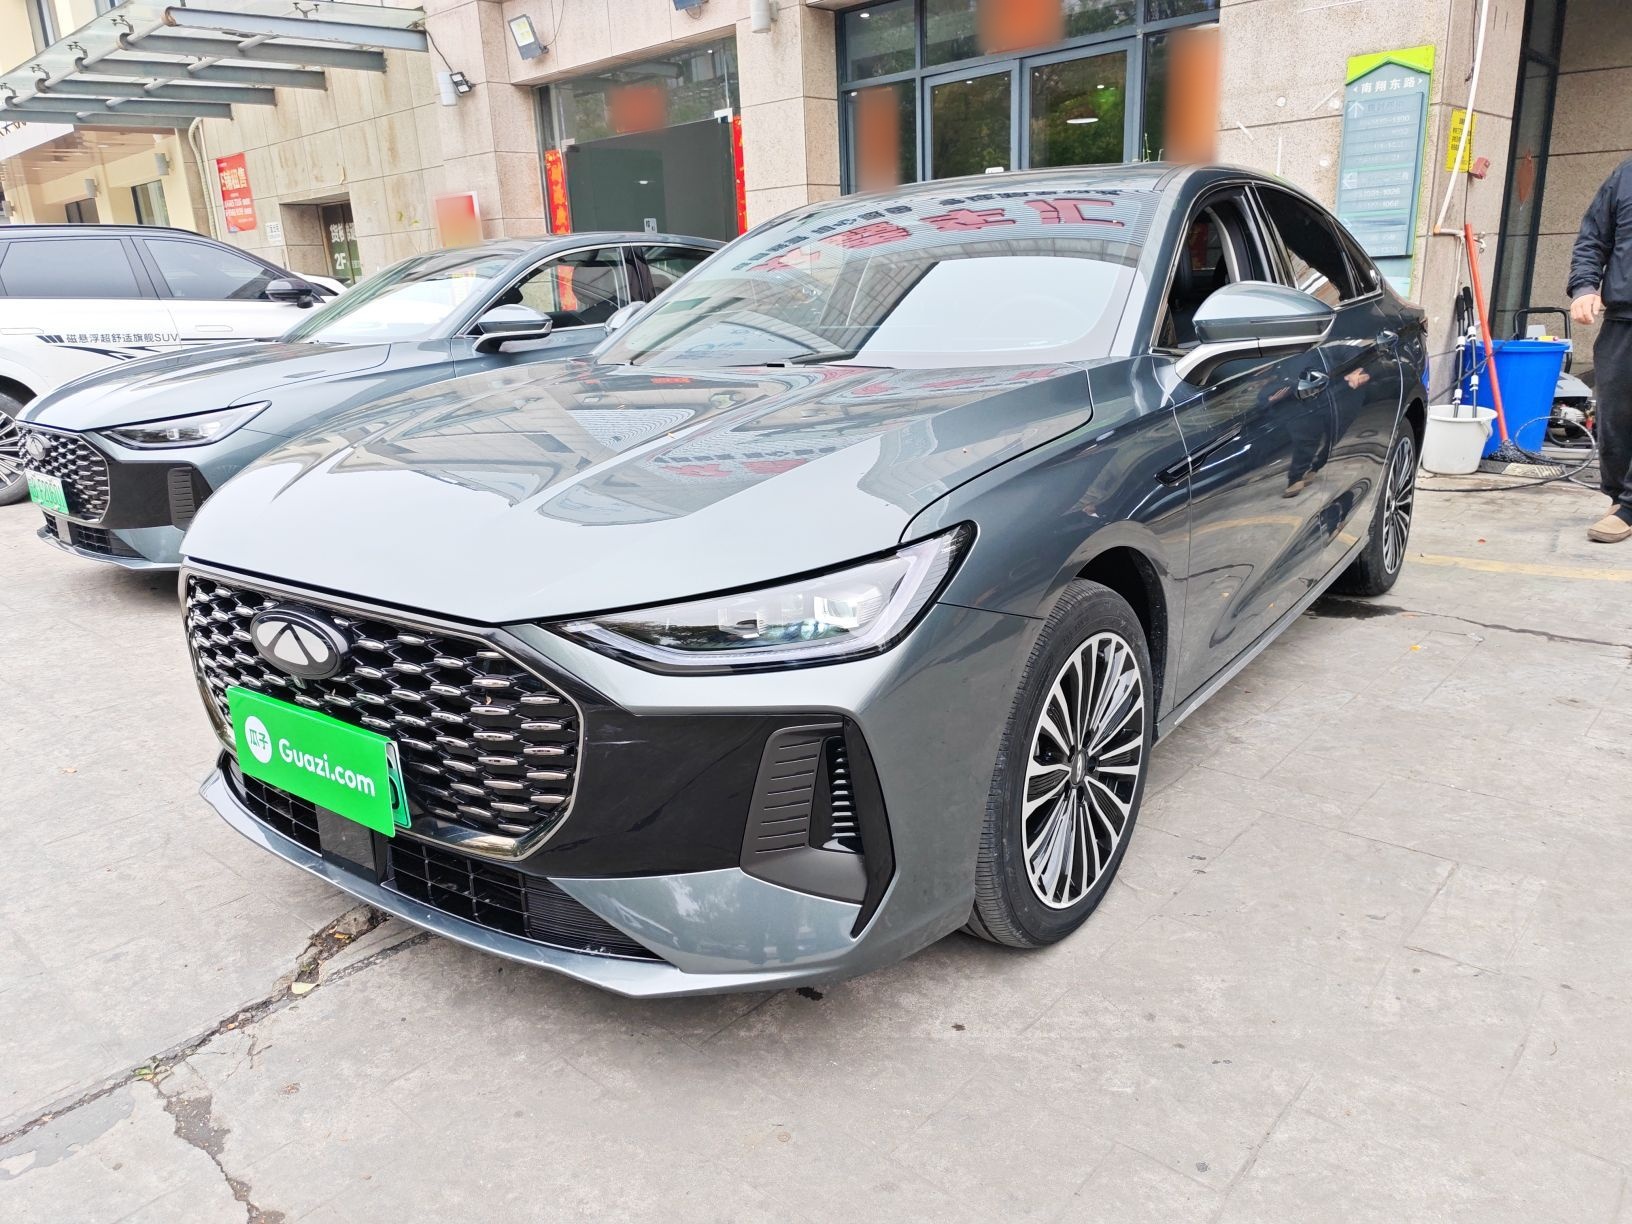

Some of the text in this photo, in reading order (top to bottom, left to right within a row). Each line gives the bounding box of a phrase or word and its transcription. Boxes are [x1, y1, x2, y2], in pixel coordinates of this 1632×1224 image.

[1361, 77, 1415, 93] 南翔东路
[334, 252, 347, 270] 2F
[66, 333, 179, 343] 磁悬浮超舒适旗舰SUV
[249, 728, 376, 797] 瓜子 Guazi.com
